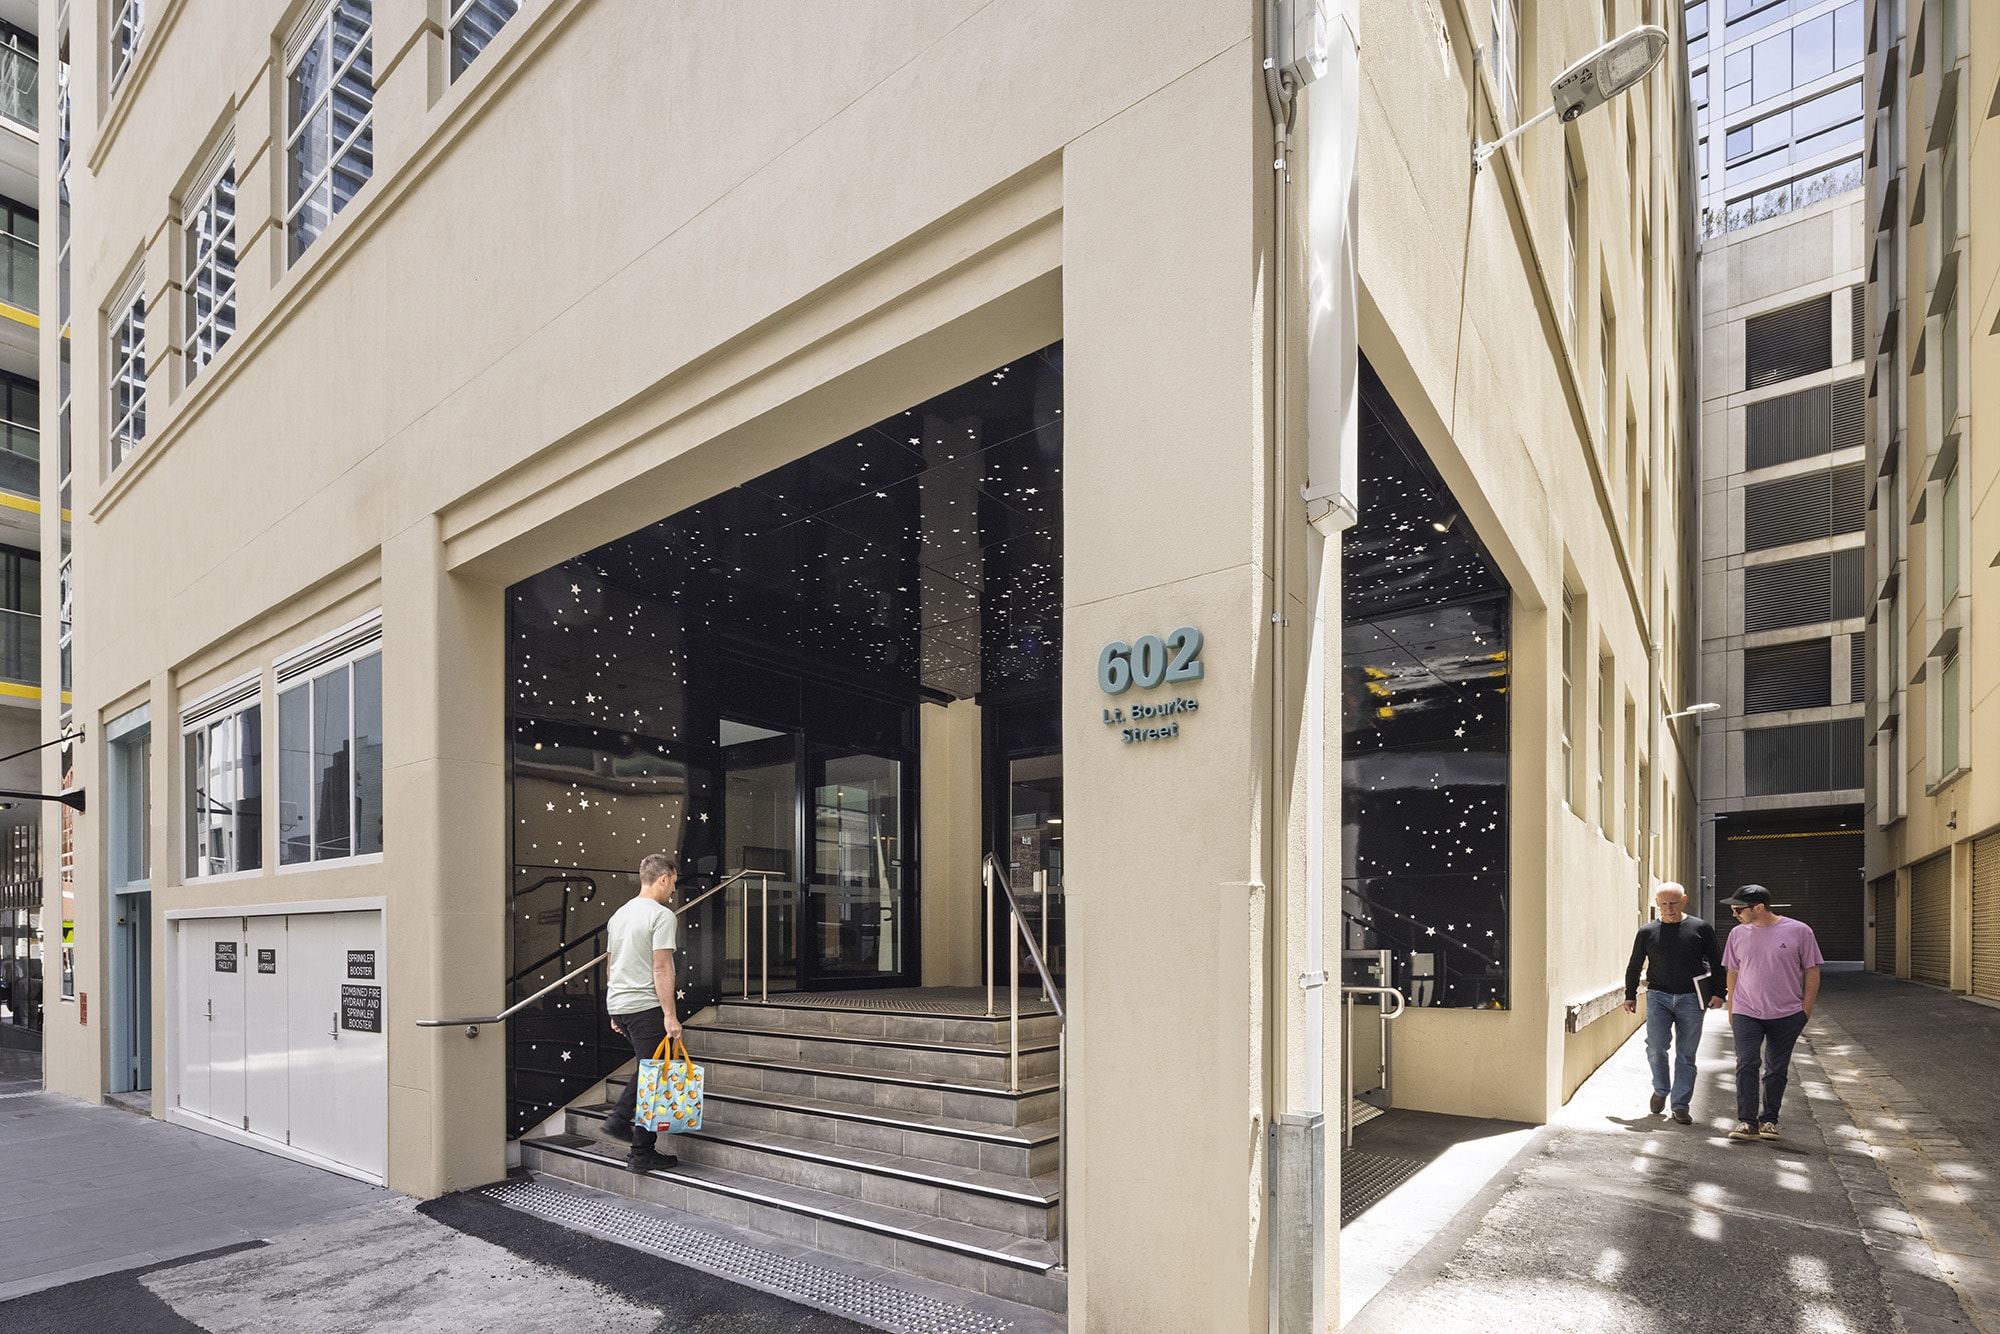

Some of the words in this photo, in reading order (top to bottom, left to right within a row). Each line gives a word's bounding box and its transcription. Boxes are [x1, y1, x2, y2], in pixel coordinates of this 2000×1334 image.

[1098, 626, 1204, 695] 602
[1103, 708, 1126, 724] Lt.
[1130, 697, 1199, 720] Bourke
[1121, 722, 1179, 744] Street
[215, 953, 236, 961] CONNECTION
[262, 952, 271, 960] FEED
[348, 953, 374, 963] SPRINKLER
[258, 962, 275, 971] HYDRANT
[350, 966, 373, 976] BOOSTER
[342, 986, 368, 997] COMBINED
[369, 988, 380, 998] FIRE
[342, 997, 366, 1007] HYDRANT
[367, 999, 379, 1009] AND
[347, 1007, 374, 1019] SPRINKLER
[349, 1018, 373, 1030] BOOSTER
